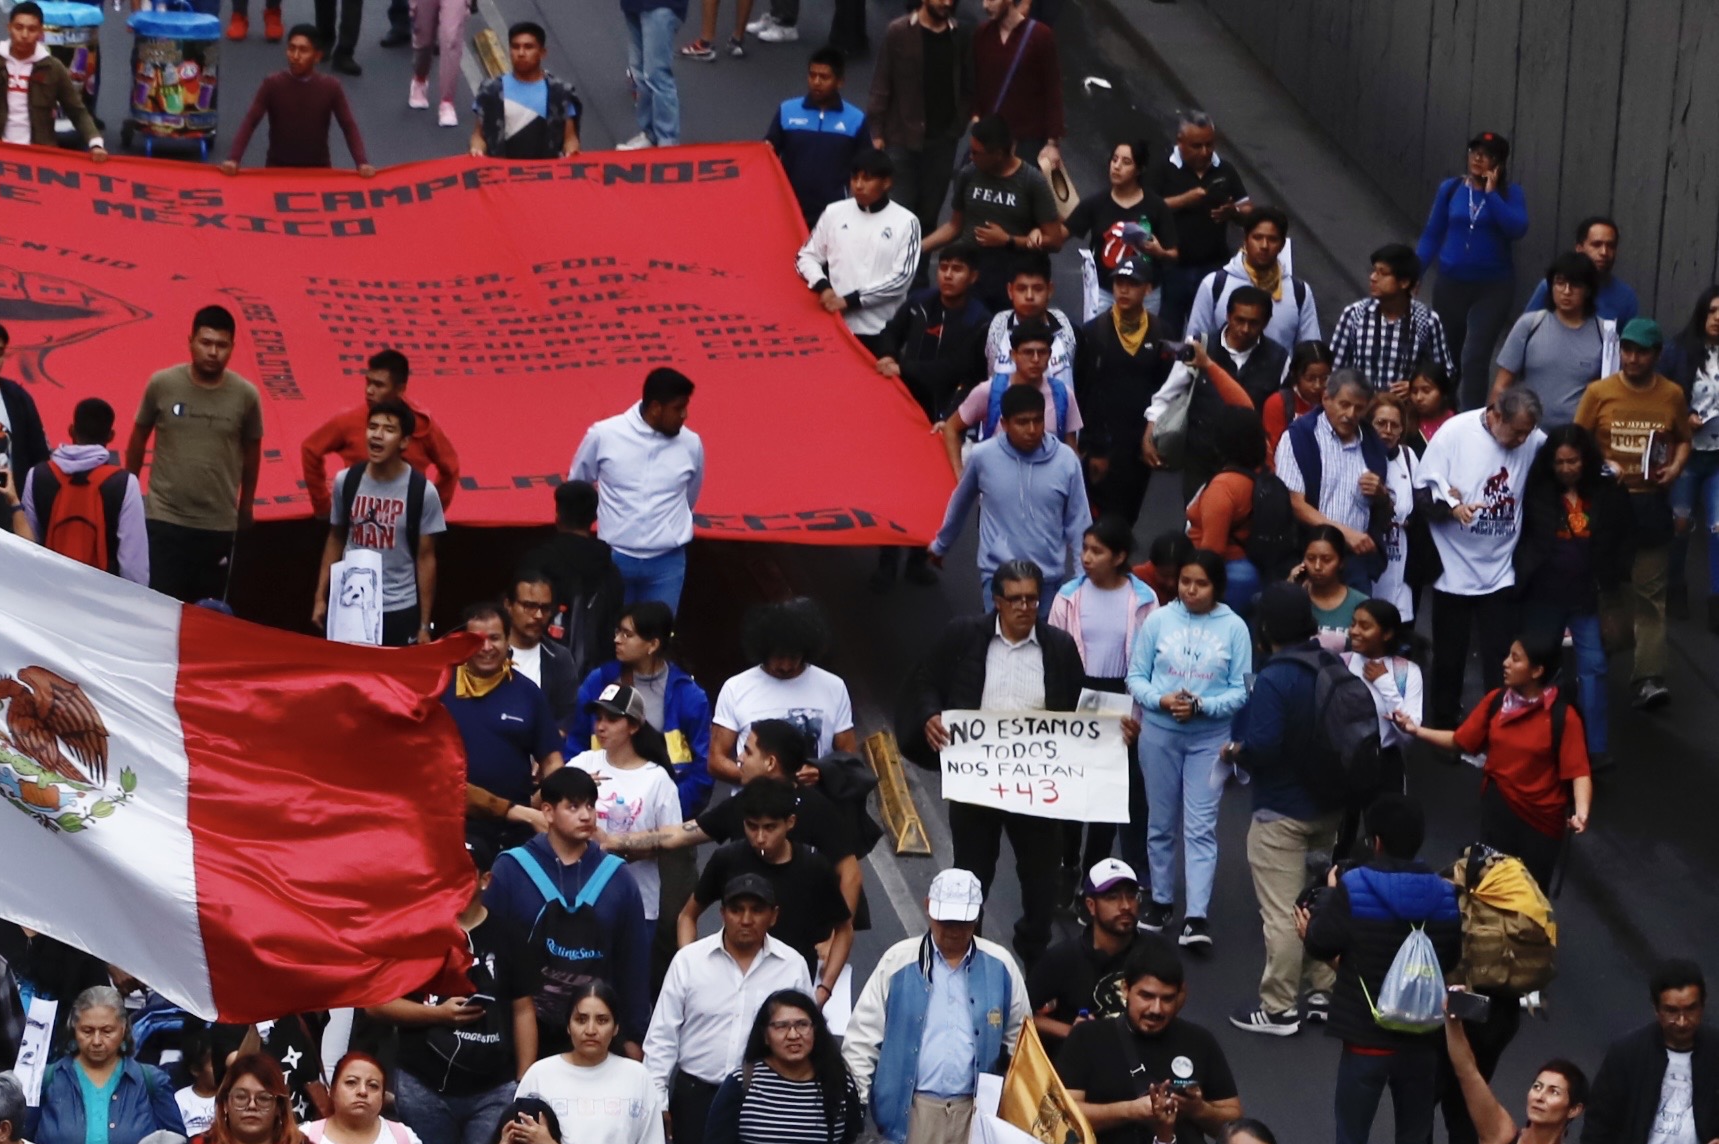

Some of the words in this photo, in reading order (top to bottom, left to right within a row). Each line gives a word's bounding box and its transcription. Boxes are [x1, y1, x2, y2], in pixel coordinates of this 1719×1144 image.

[273, 158, 740, 213] CAMPESINOS
[972, 187, 1017, 207] FEAR
[349, 523, 396, 550] MAN
[949, 720, 985, 746] NO
[998, 719, 1101, 741] ESTAMOS
[947, 761, 988, 777] NOS
[998, 762, 1085, 779] FALTAN
[989, 780, 1060, 805] +43
